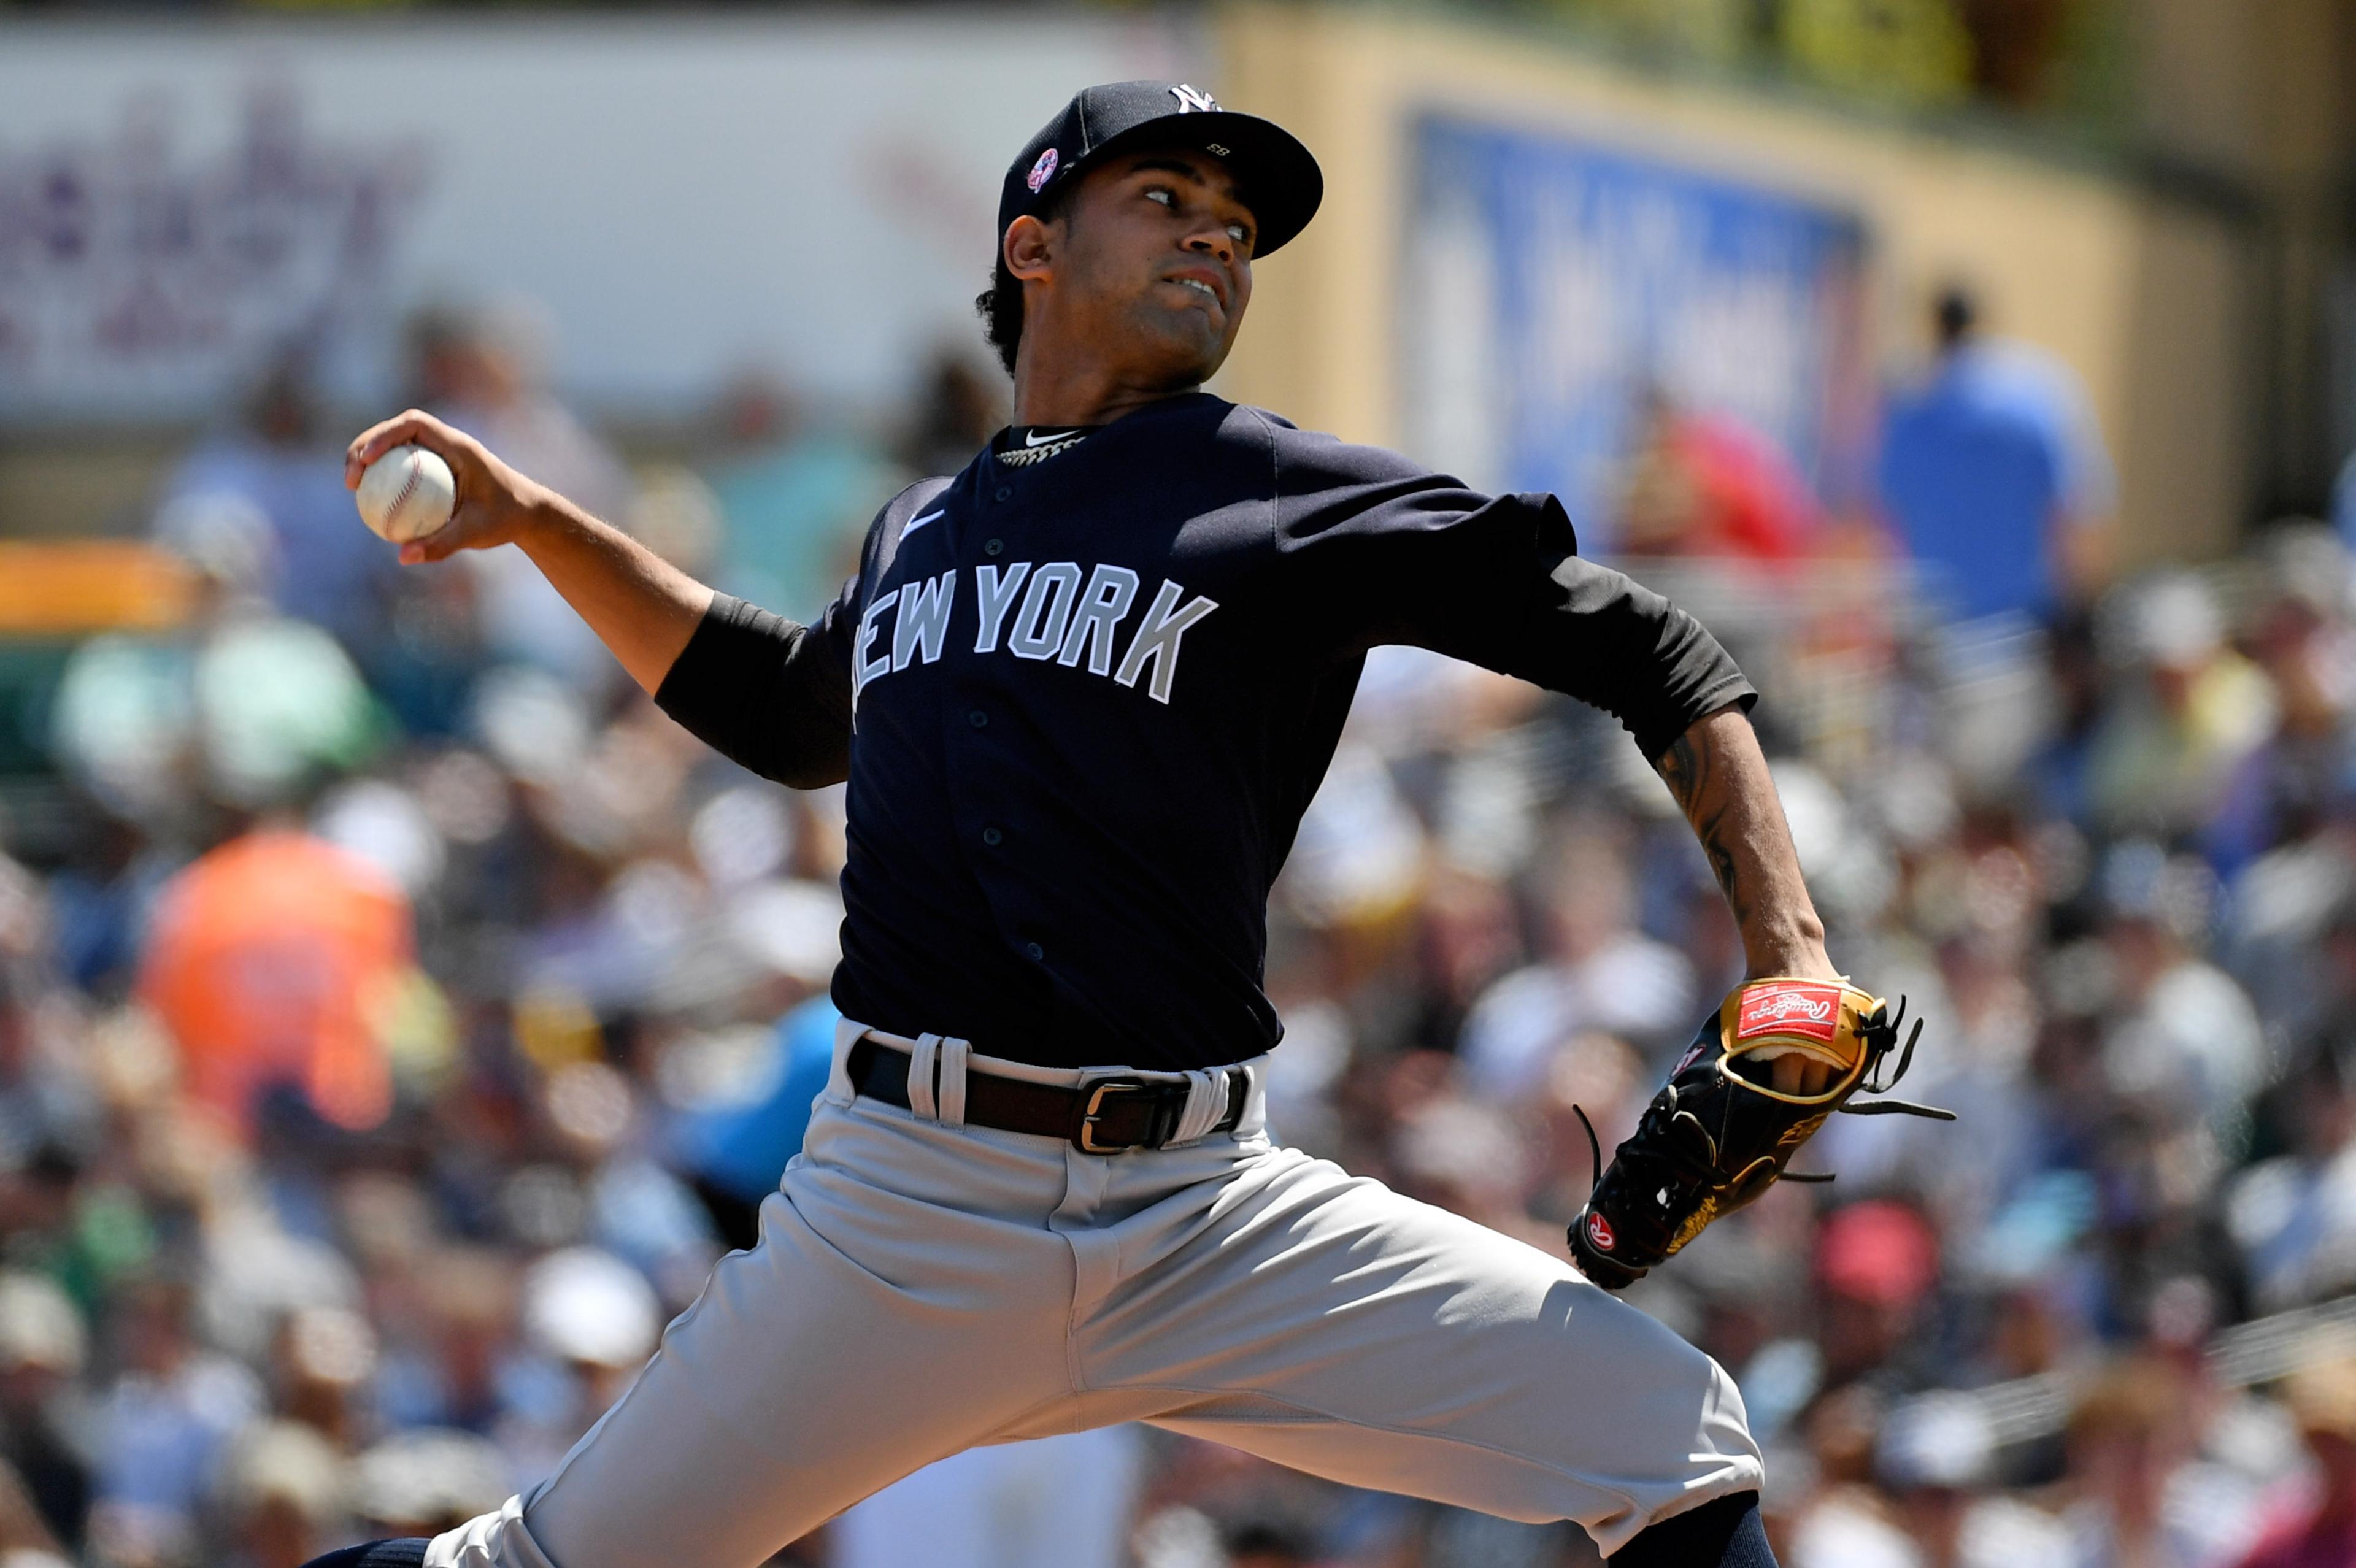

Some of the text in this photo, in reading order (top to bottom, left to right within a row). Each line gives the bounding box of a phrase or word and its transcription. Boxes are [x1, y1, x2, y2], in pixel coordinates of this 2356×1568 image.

[852, 561, 1220, 734] EW YORK
[1747, 994, 1831, 1021] Rawlings
